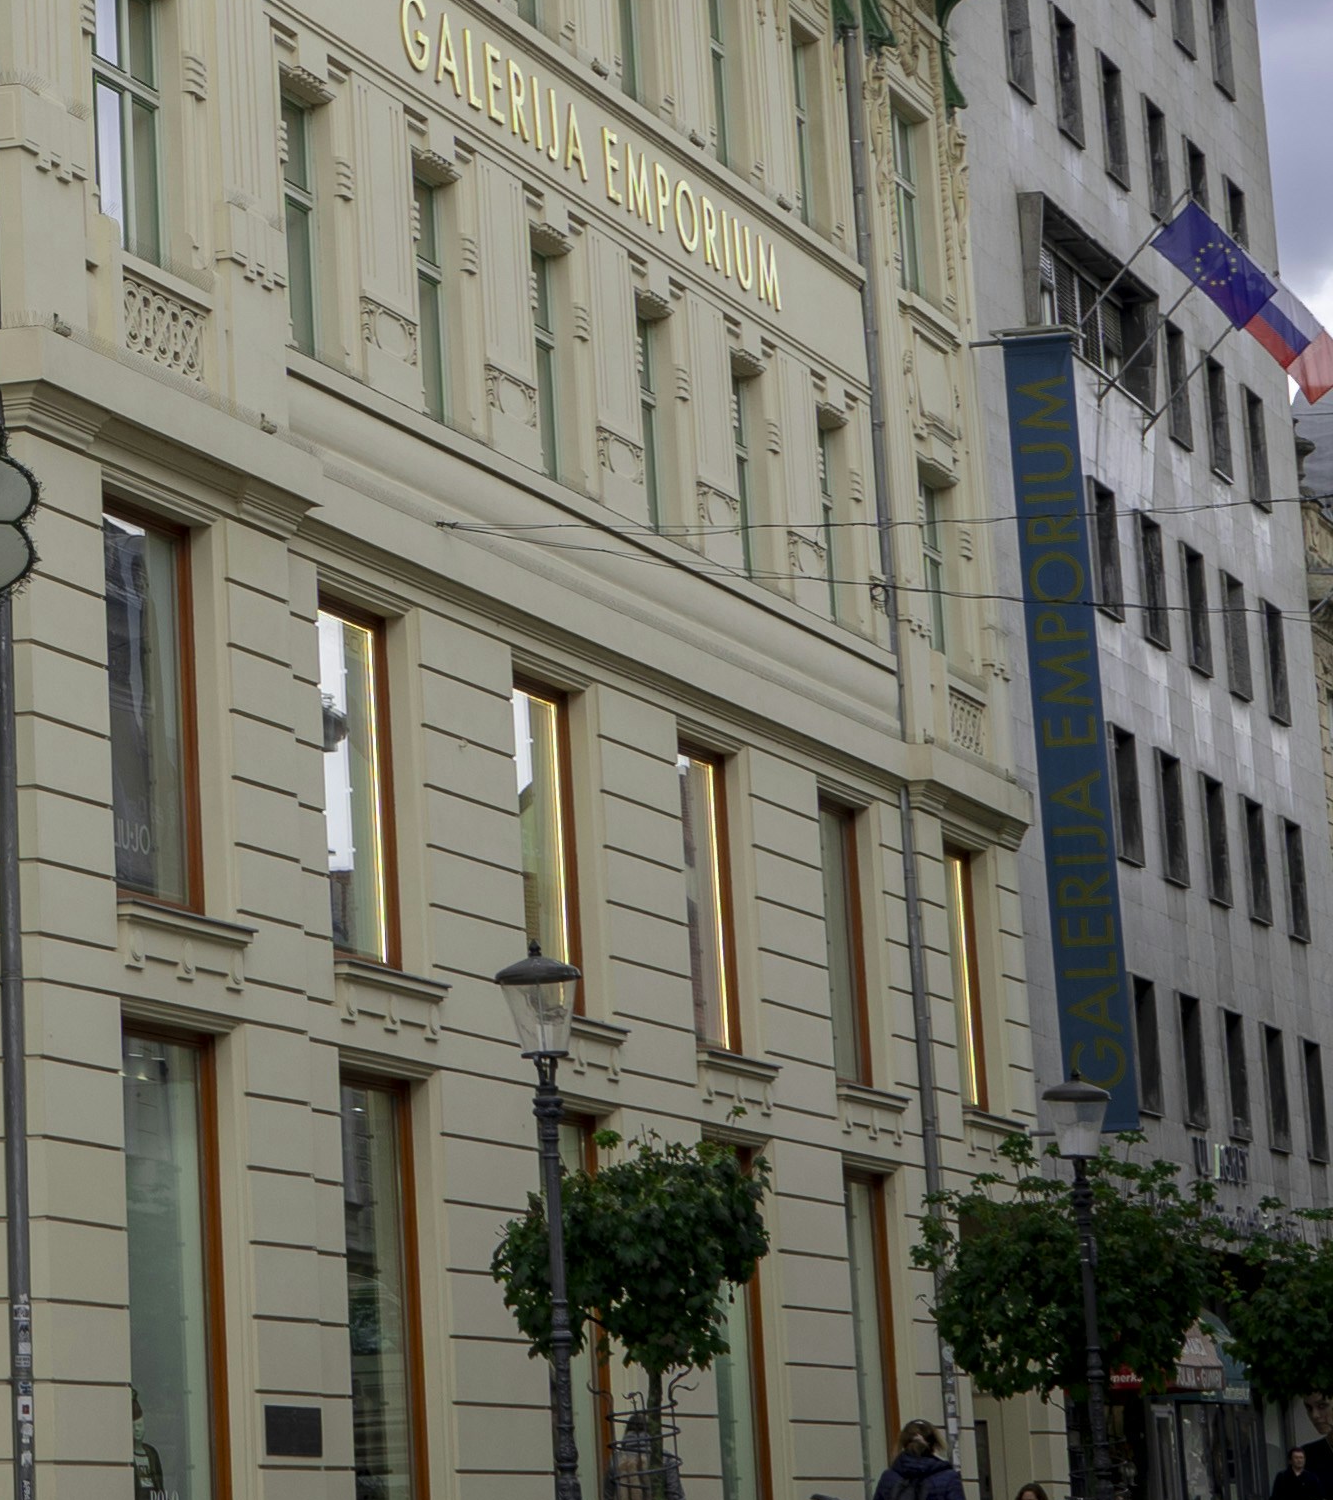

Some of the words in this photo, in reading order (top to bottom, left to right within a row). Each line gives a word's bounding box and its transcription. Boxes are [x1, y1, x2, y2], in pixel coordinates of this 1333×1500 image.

[601, 126, 784, 311] EMPORIUM
[1015, 375, 1098, 751] EMPORIUM
[1049, 768, 1128, 1091] GALERIJA
